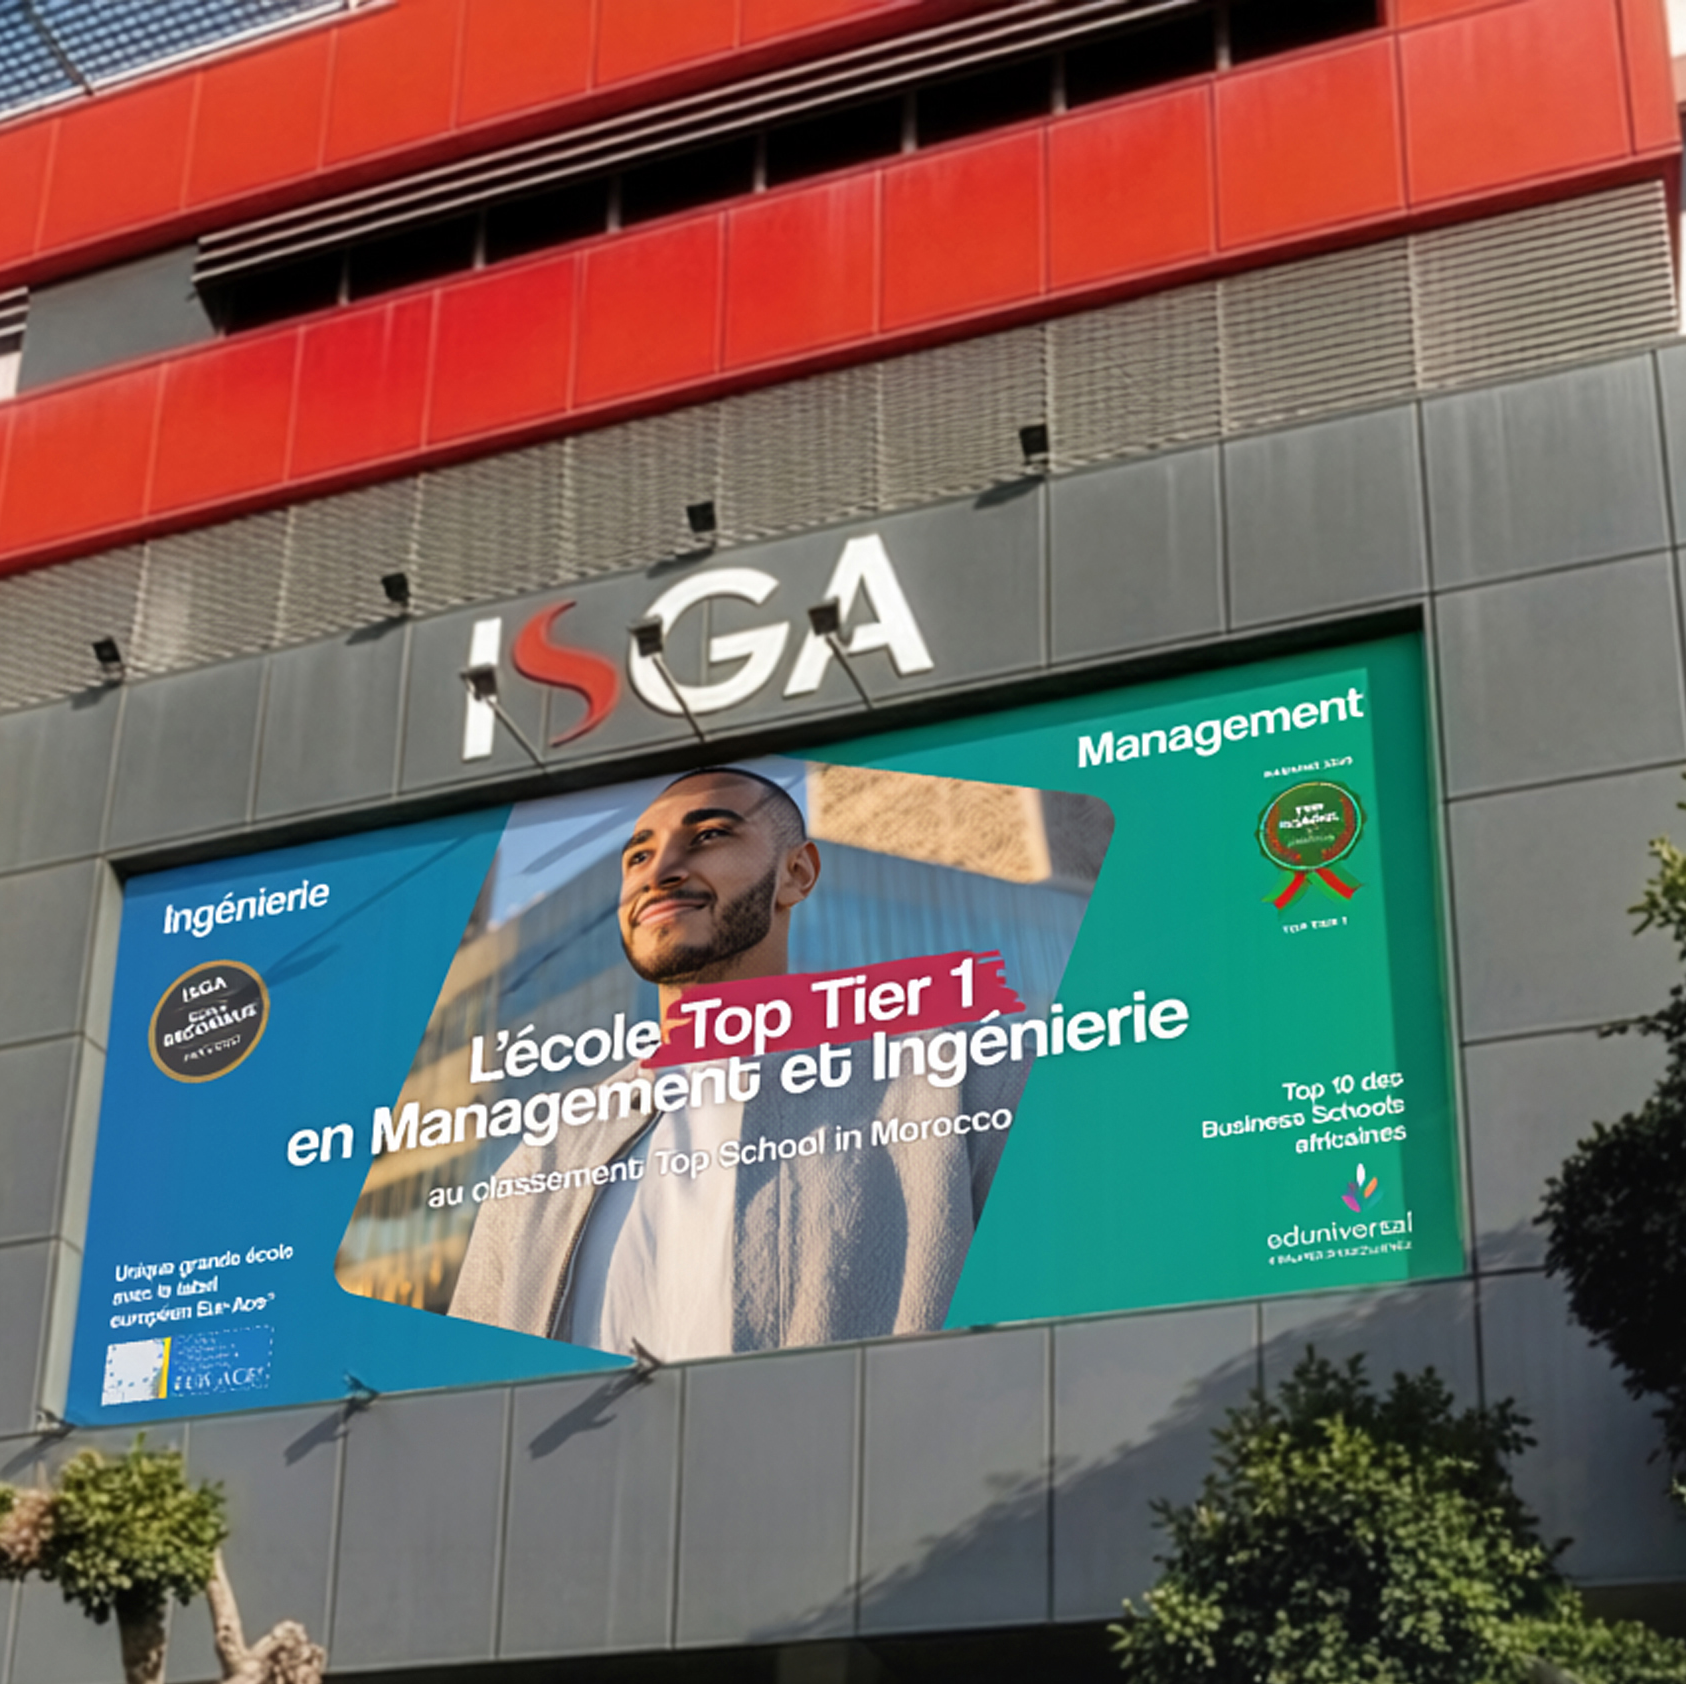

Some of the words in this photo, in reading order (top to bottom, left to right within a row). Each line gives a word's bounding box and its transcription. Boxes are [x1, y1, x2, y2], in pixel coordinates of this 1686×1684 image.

[462, 533, 934, 761] ISGA
[1077, 688, 1364, 767] Management
[164, 880, 329, 938] Ingénierie
[681, 998, 792, 1056] Top
[812, 974, 931, 1029] Tier
[951, 958, 975, 1008] 1
[287, 1123, 354, 1167] en
[372, 1056, 761, 1155] Management
[780, 1043, 852, 1095] et
[871, 990, 1190, 1088] Ingénierie
[1202, 1115, 1305, 1138] Business
[1312, 1094, 1405, 1124] Schools
[1282, 1082, 1325, 1104] Top
[1332, 1074, 1355, 1094] 10
[428, 1183, 463, 1209] au
[656, 1150, 709, 1179] Top
[719, 1122, 825, 1166] School
[835, 1125, 862, 1151] in
[870, 1108, 1013, 1145] Morocco
